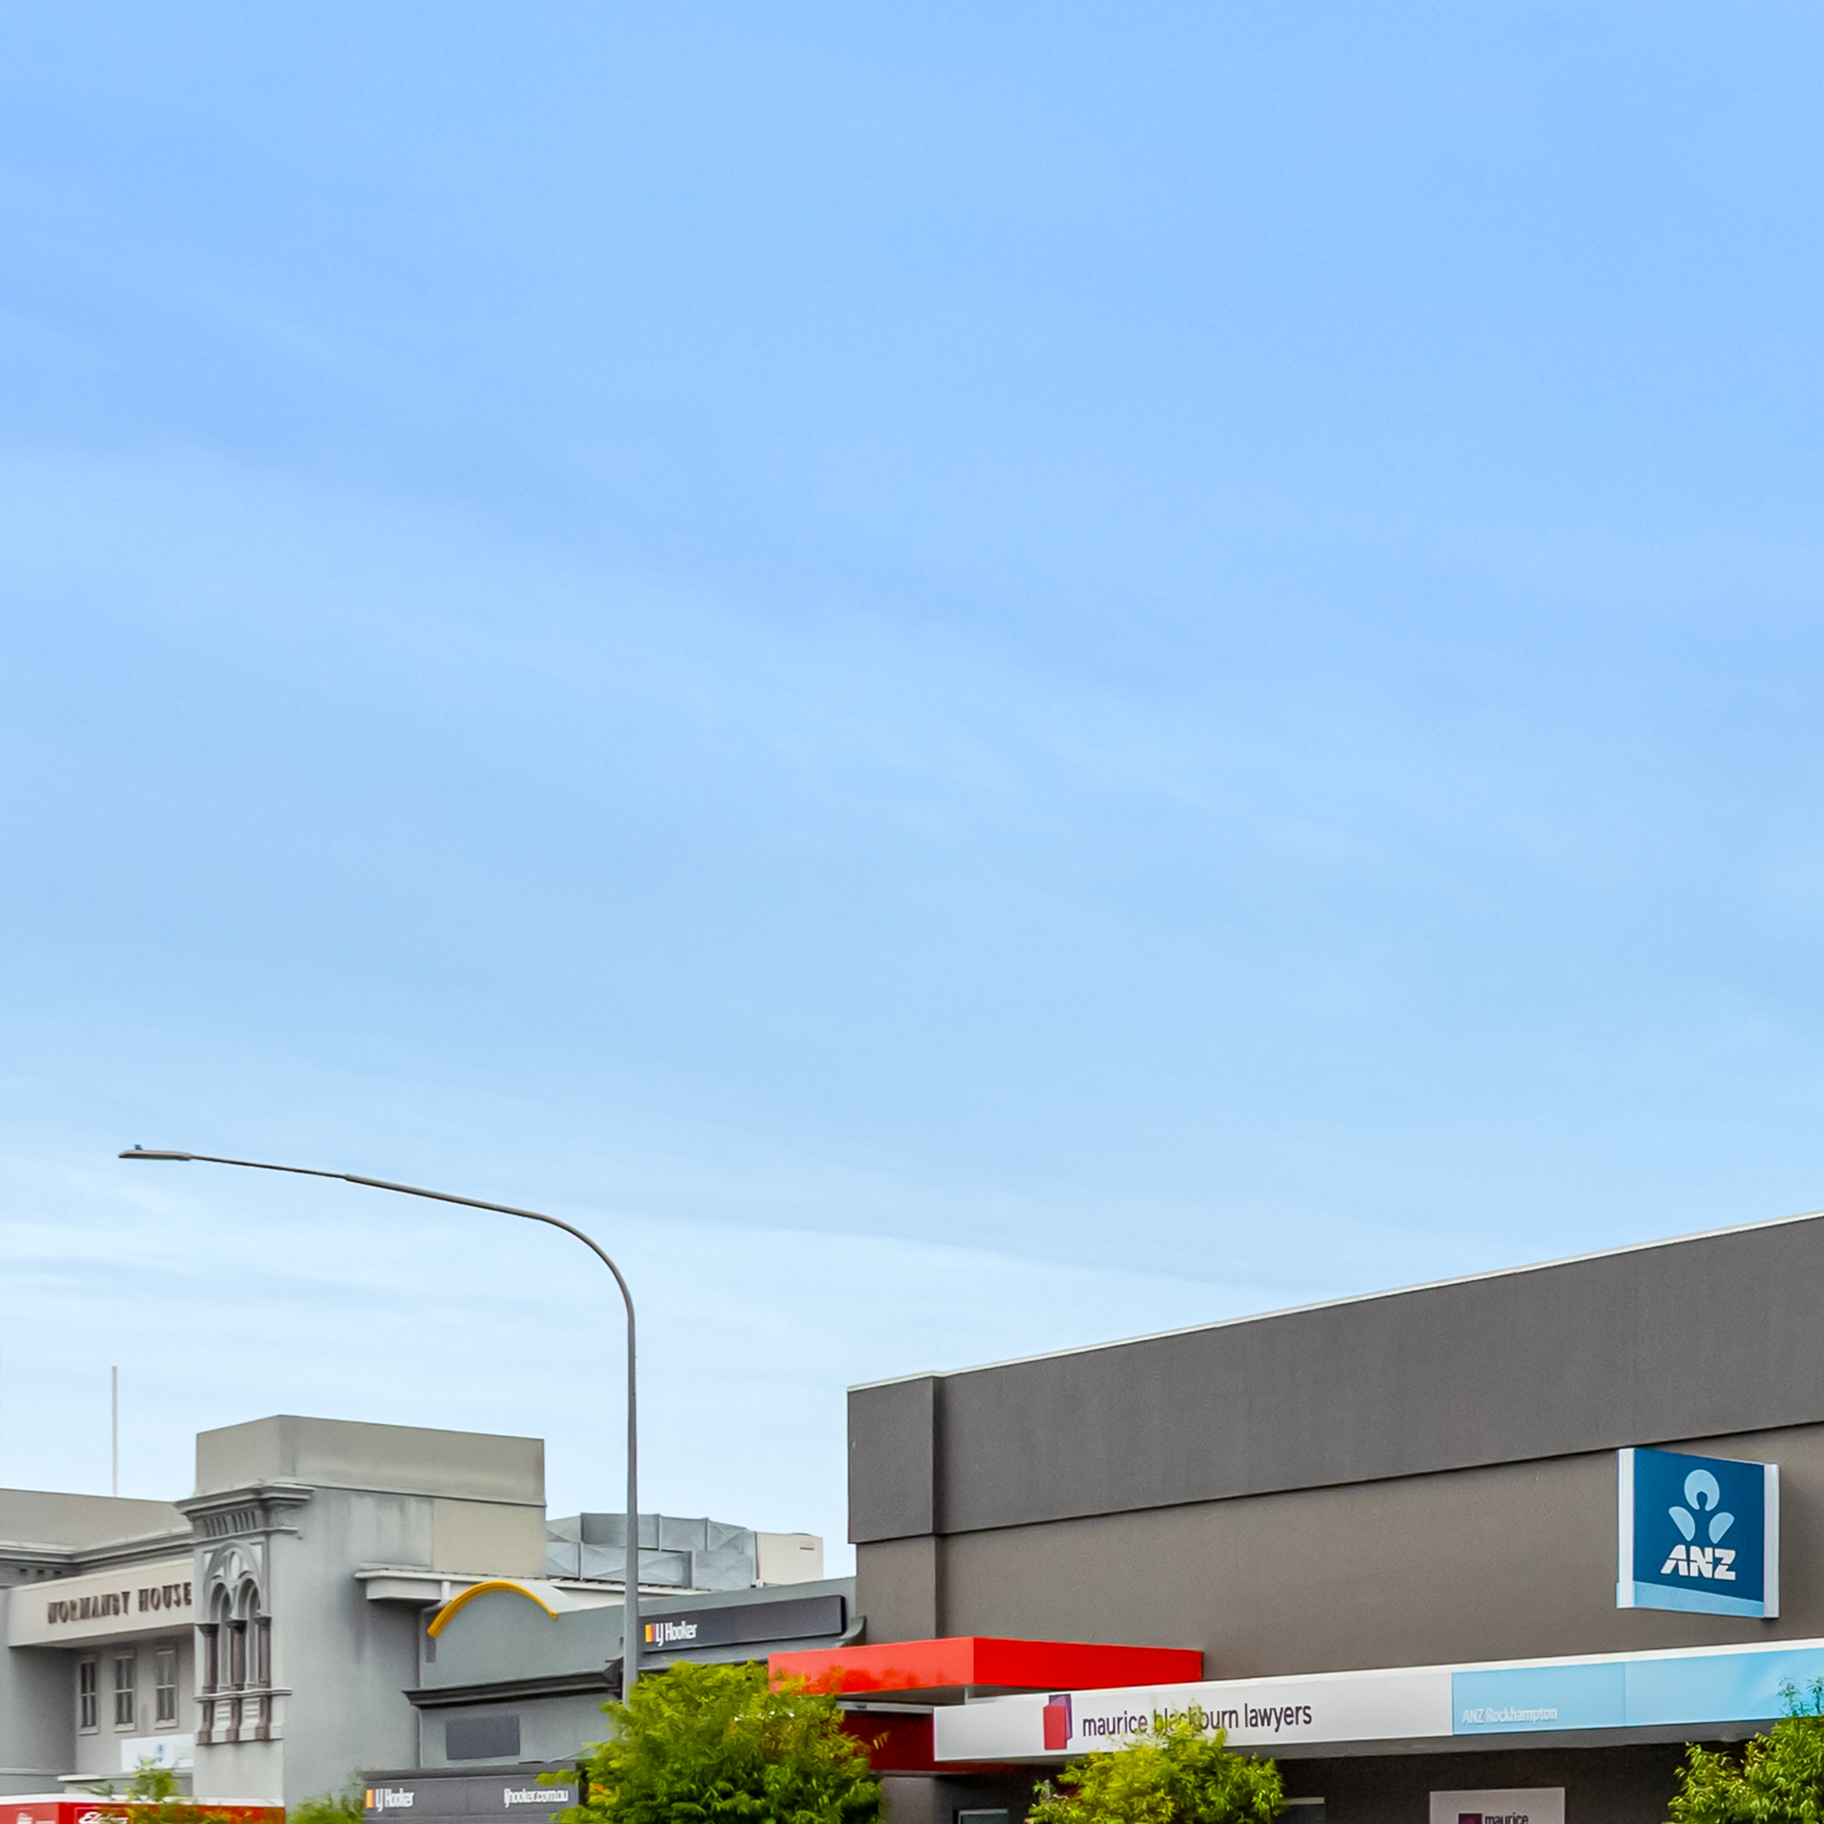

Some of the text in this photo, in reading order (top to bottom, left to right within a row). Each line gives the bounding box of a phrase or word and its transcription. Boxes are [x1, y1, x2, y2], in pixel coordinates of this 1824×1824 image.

[1661, 1544, 1736, 1580] ANZ
[47, 1582, 192, 1624] NORMANBY HOUSE
[665, 1620, 698, 1641] Hooker
[1083, 1710, 1148, 1737] maurice
[1245, 1703, 1312, 1732] lawyers
[1462, 1707, 1558, 1724] ANZ Rockhampton
[384, 1788, 414, 1808] Hooker
